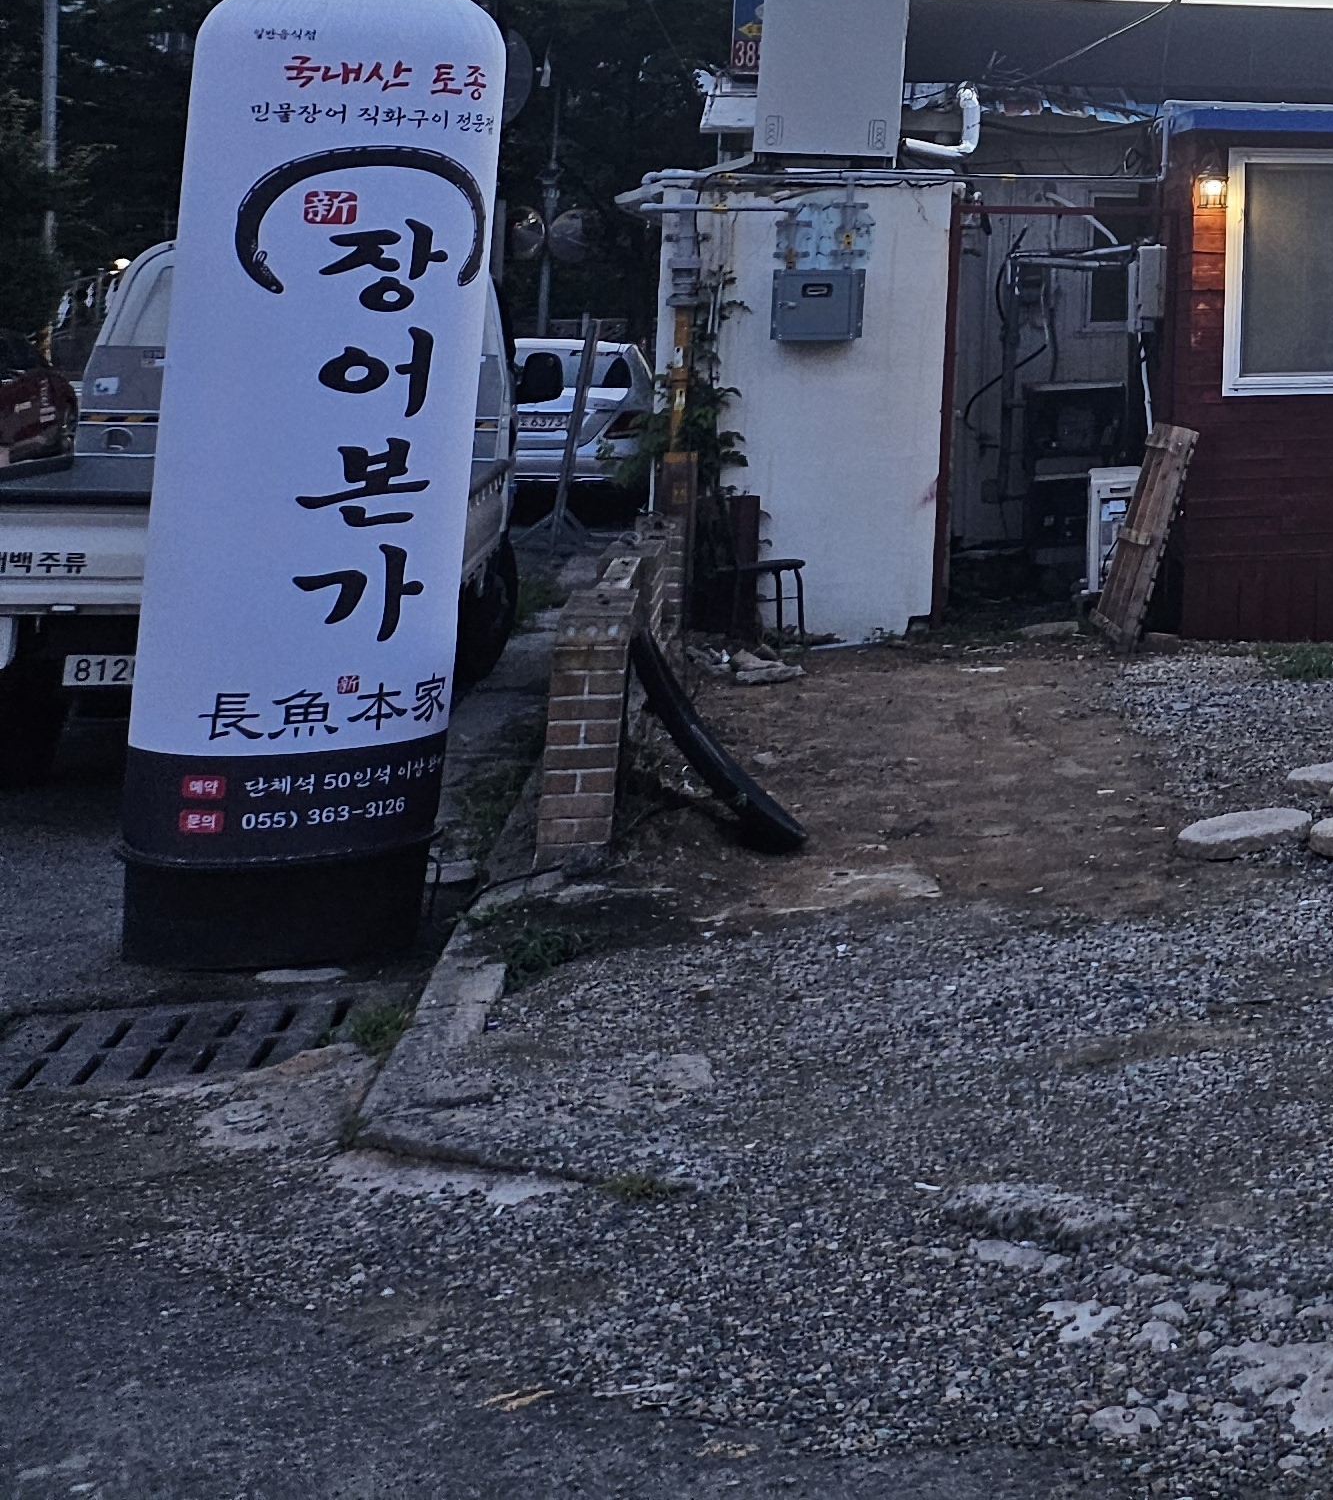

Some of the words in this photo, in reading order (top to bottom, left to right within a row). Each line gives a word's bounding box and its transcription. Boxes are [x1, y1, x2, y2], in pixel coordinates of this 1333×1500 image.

[735, 41, 760, 66] 38
[284, 56, 413, 92] 국내산
[430, 64, 487, 100] 토종
[251, 102, 346, 124] 민물장어
[358, 106, 448, 129] 직화구이
[304, 191, 357, 224] 新
[292, 218, 448, 641] 장어본가
[74, 658, 136, 682] 812
[198, 673, 446, 740] 長魚本家
[188, 779, 219, 793] 예약
[244, 774, 315, 798] 단체석
[323, 765, 392, 790] 50인석
[398, 758, 424, 779] 이상
[187, 813, 217, 829] 문의
[242, 812, 298, 830] 055)
[307, 796, 405, 825] 363-3126
